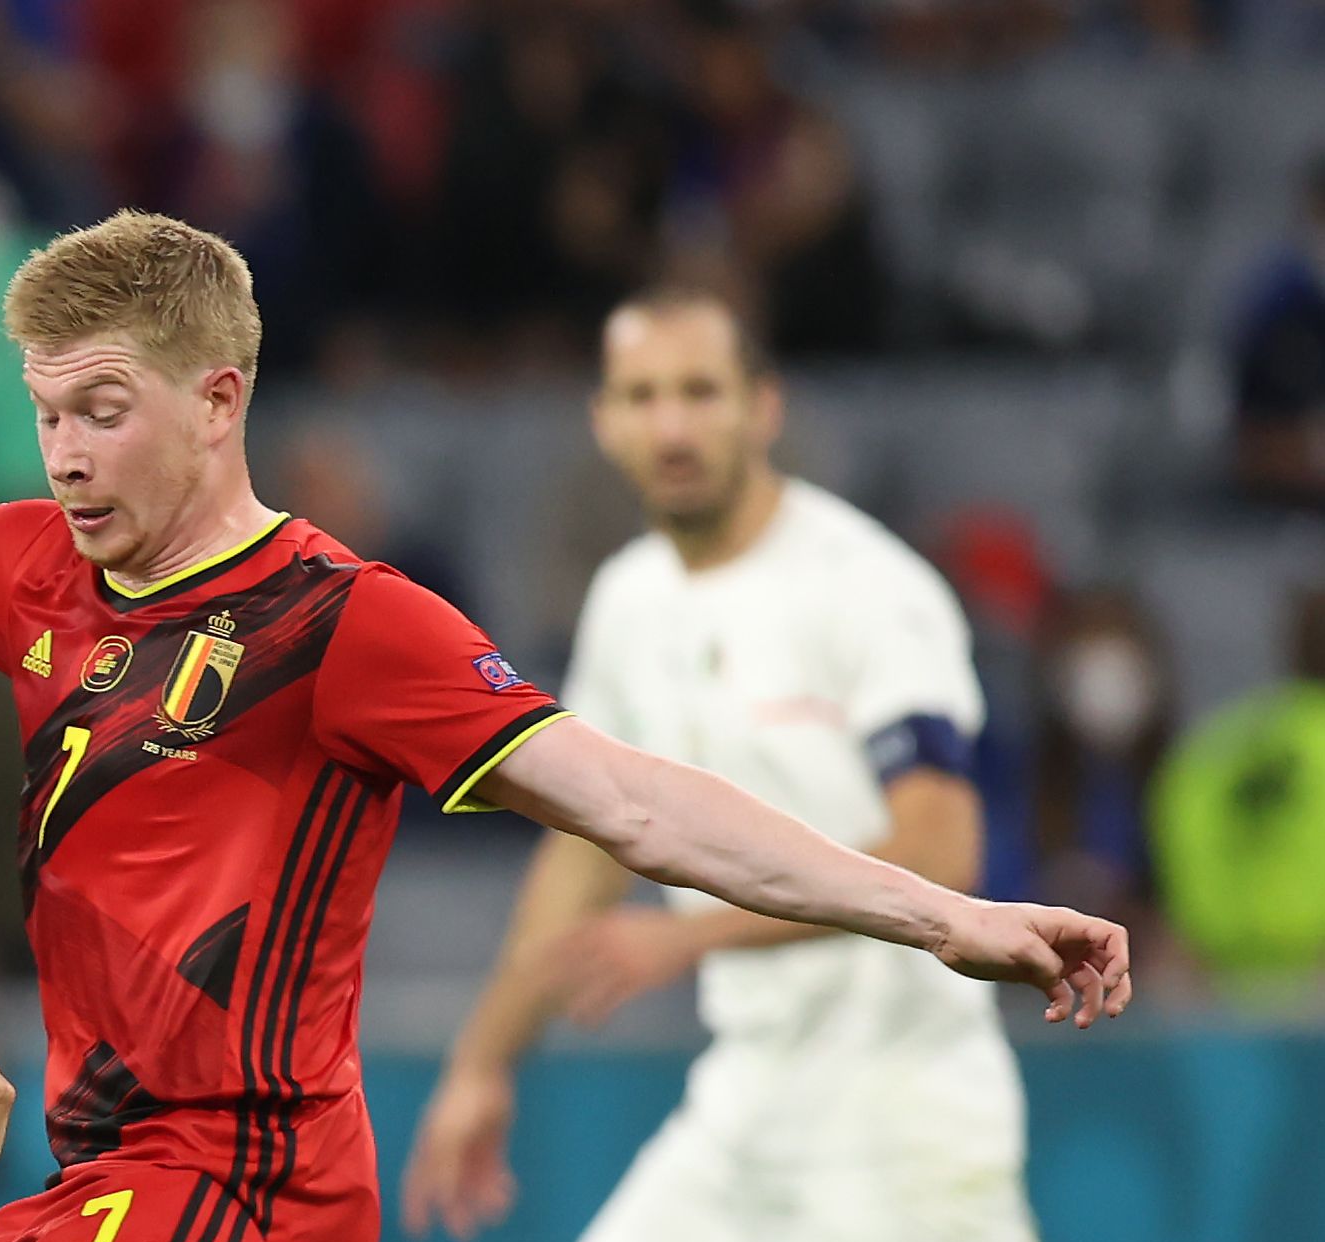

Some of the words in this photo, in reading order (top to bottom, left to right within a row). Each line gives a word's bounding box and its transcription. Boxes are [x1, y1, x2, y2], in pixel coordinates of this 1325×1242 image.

[141, 740, 160, 755] 125
[161, 747, 198, 761] YEARS
[38, 725, 91, 849] 7
